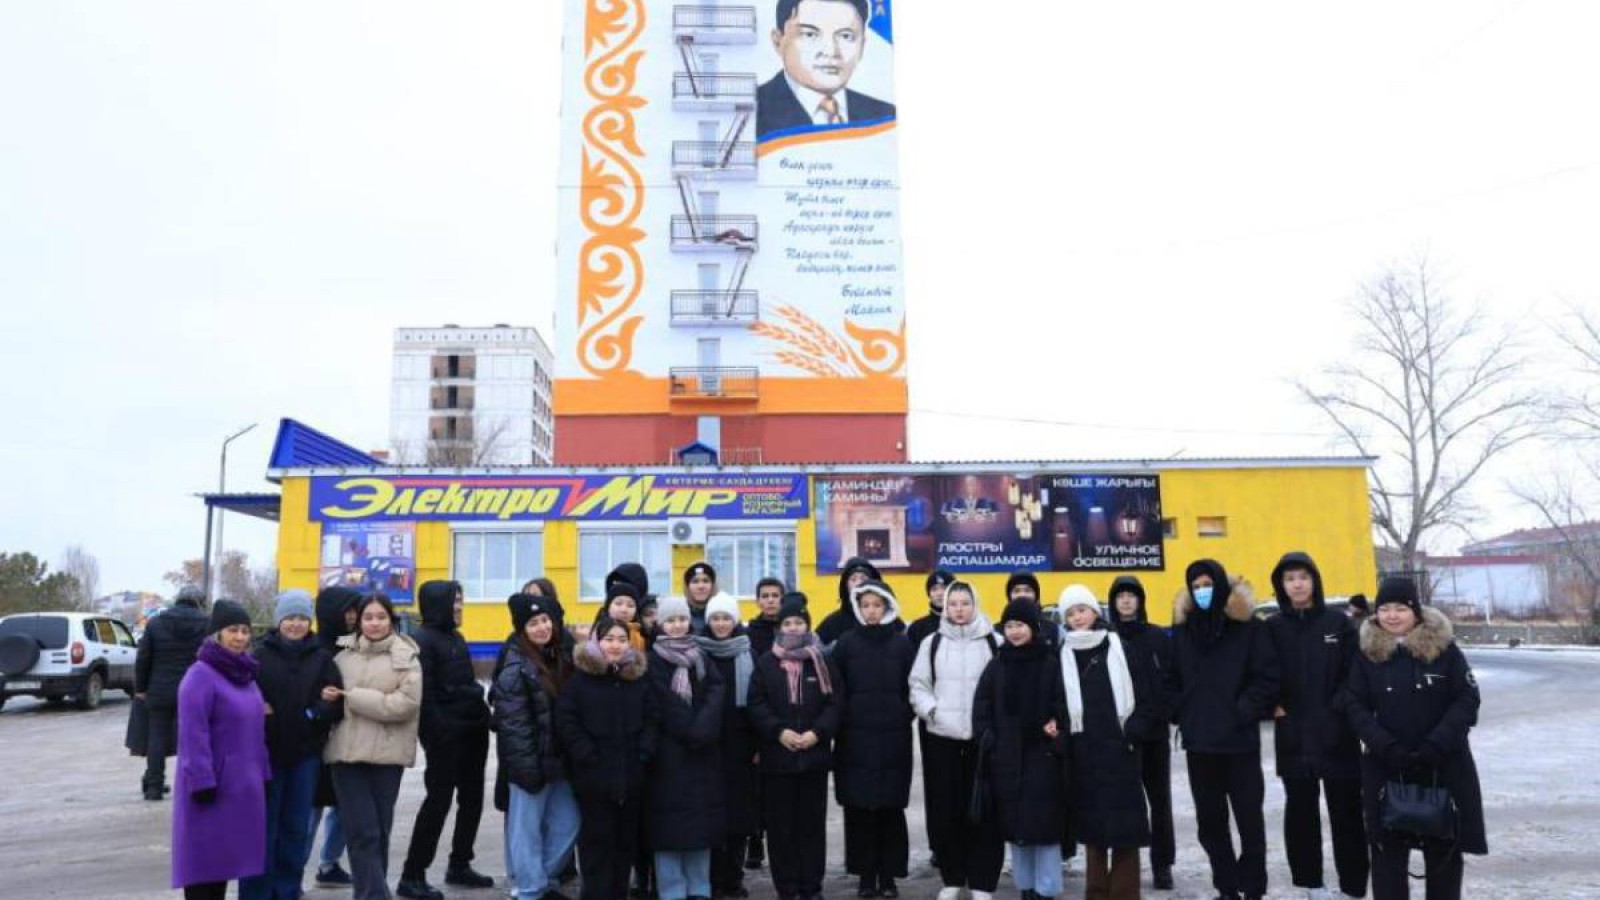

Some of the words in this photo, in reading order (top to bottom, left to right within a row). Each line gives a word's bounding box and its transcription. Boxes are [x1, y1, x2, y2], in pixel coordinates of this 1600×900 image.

[320, 477, 559, 519] Электро
[824, 492, 889, 503] КАМИНЫ
[939, 542, 1003, 553] ЛЮСТРЫ
[1095, 545, 1160, 555] УЛИЧНОЕ
[939, 555, 1046, 566] АСПАШАМДАР
[1073, 556, 1160, 567] ОСВЕЩЕНИЕ
